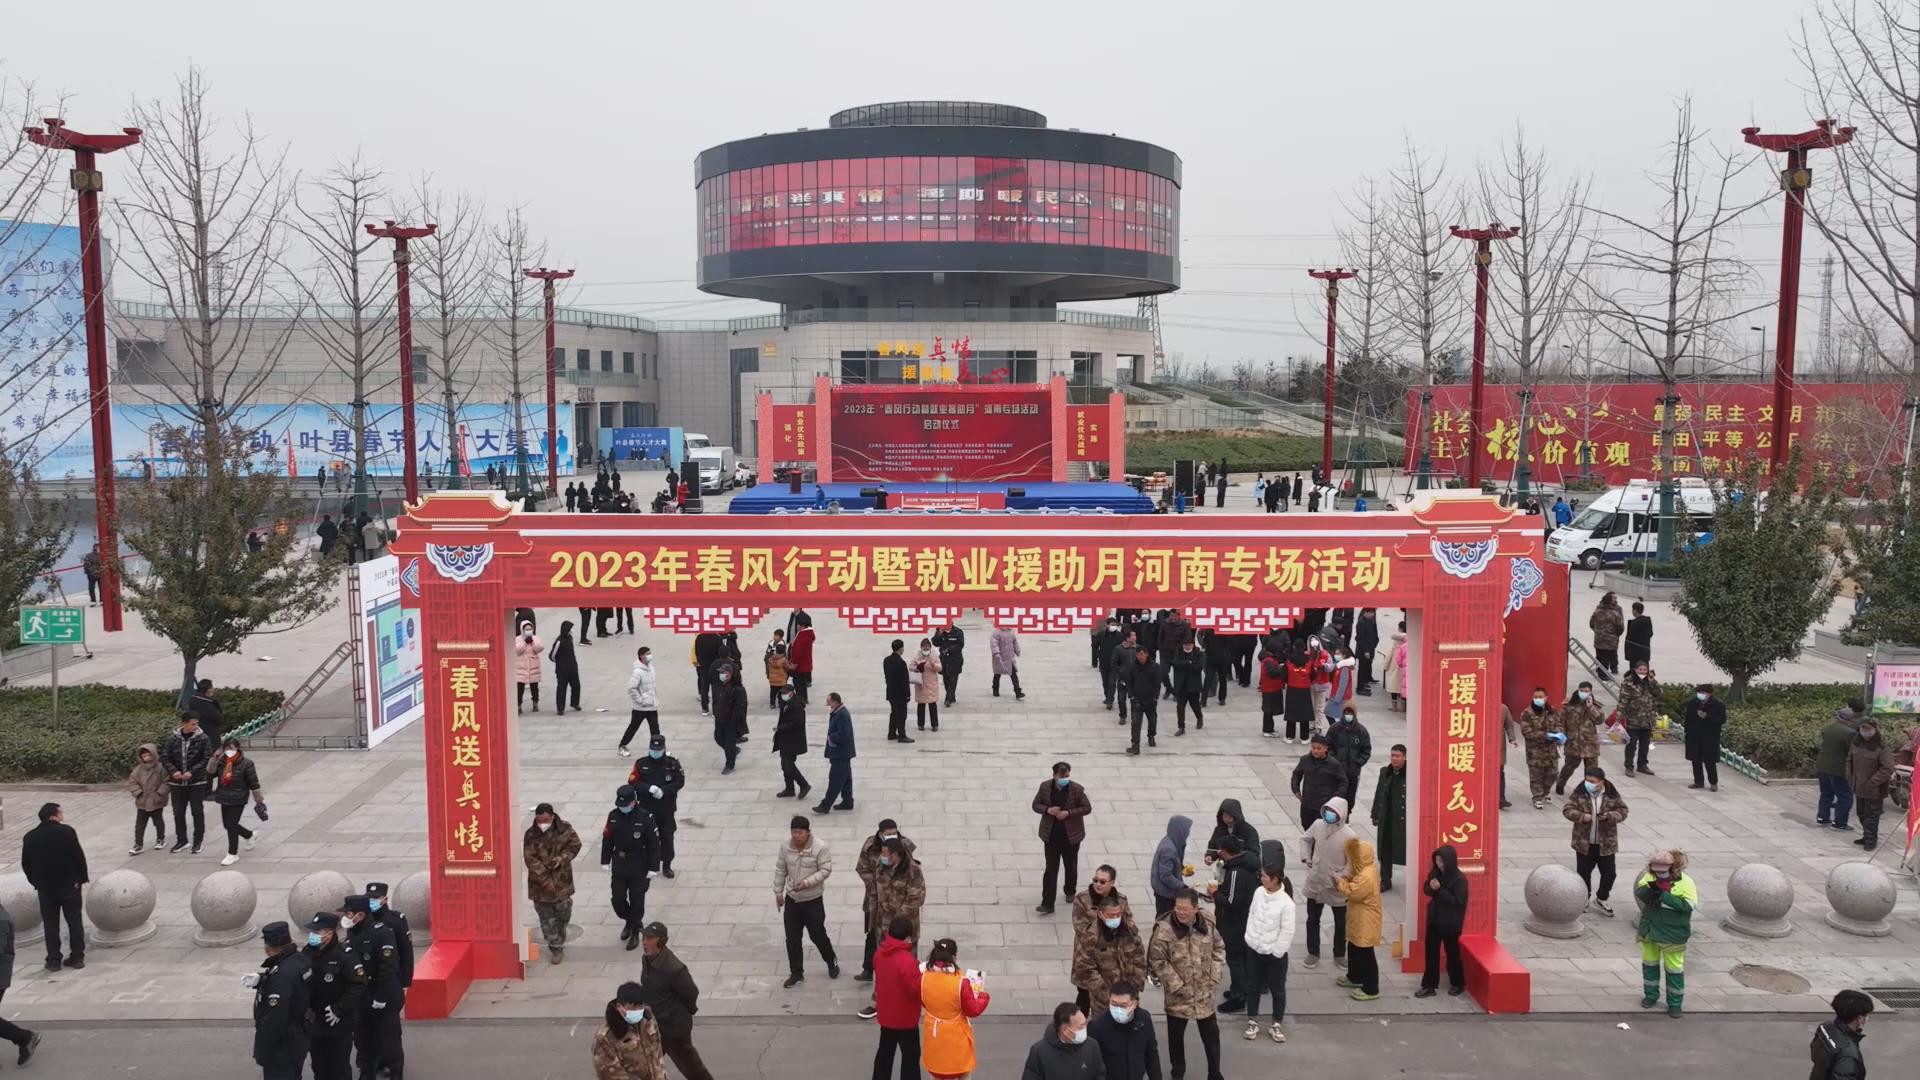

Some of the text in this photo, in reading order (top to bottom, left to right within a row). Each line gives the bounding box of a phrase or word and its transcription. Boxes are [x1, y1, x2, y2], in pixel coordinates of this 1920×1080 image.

[1705, 405, 1745, 423] 民主
[161, 428, 529, 454] 春风动·叶县春节人大集
[1485, 409, 1567, 462] 核心
[1542, 440, 1631, 467] 价值观
[1702, 430, 1744, 449] 平等
[549, 545, 1391, 593] 2023年春风行动暨就业援助月河南专场活动
[450, 665, 484, 853] 春风送真情
[1442, 673, 1477, 843] 援助暖民心
